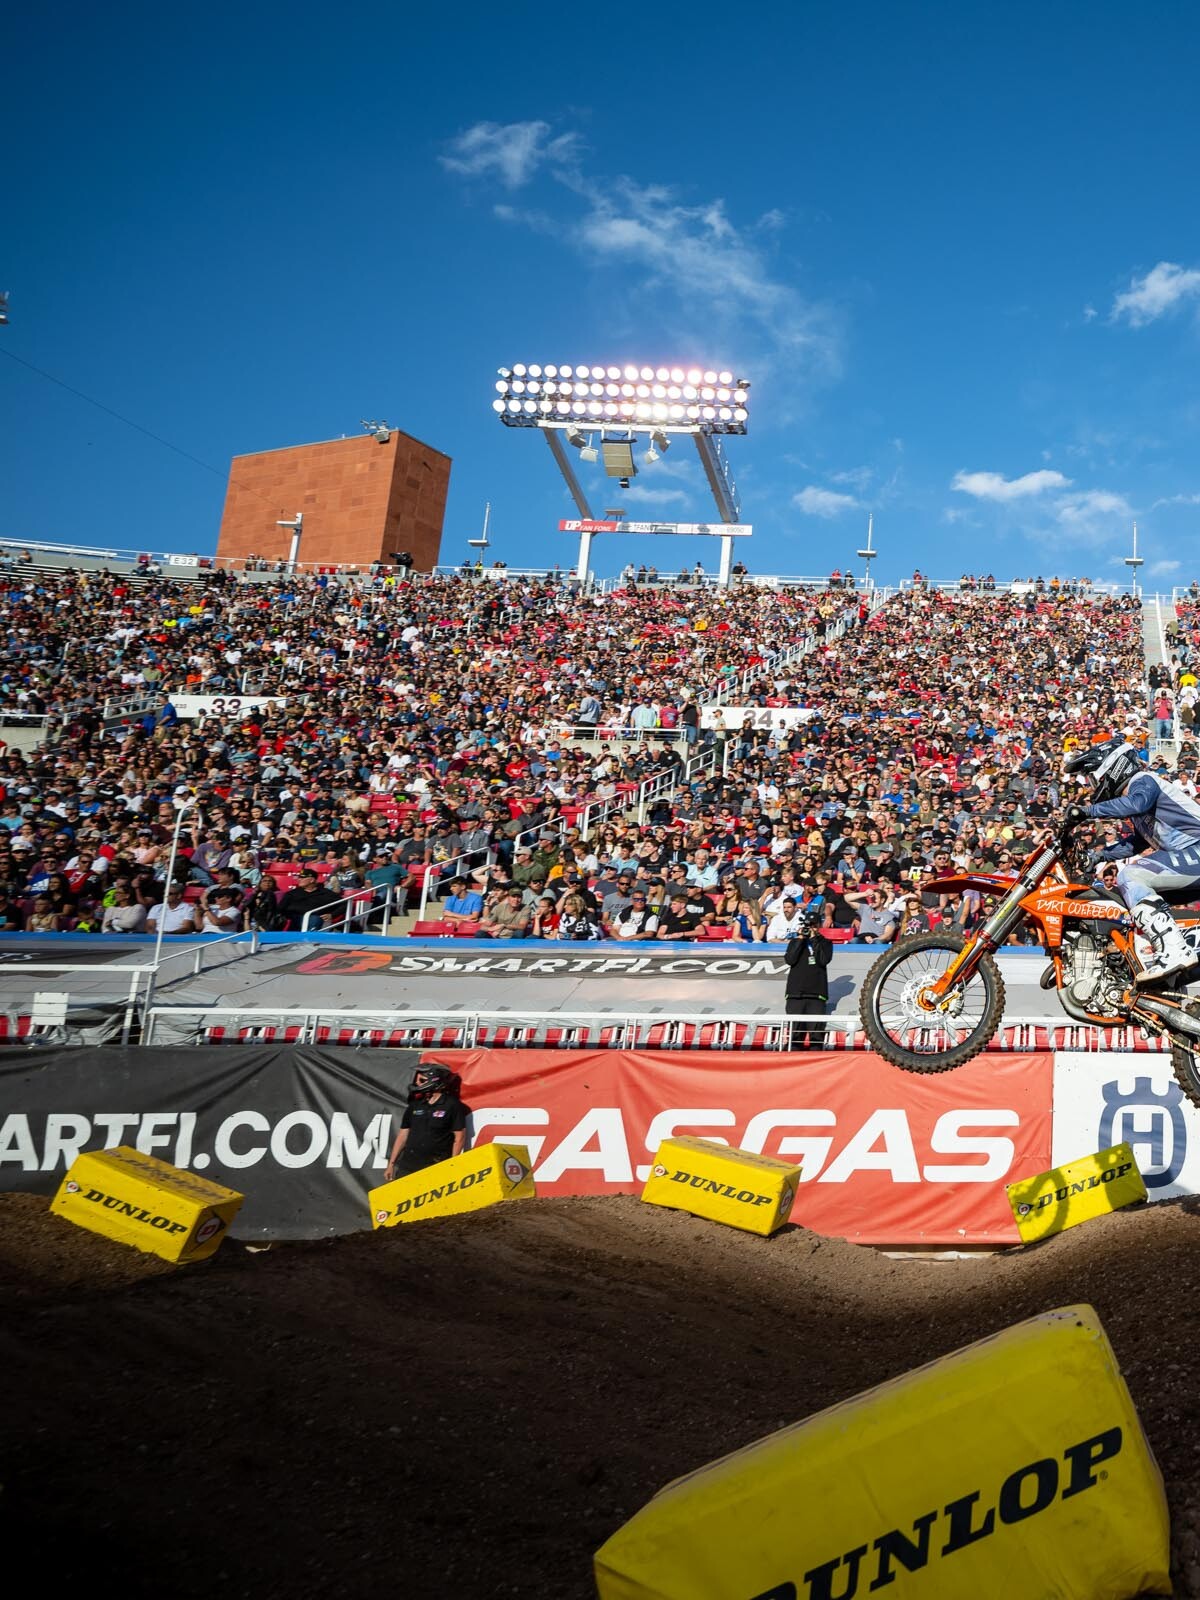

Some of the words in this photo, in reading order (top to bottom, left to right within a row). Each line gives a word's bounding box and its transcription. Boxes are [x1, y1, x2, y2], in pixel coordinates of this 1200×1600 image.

[174, 556, 194, 566] E32
[211, 698, 242, 716] 33
[743, 709, 773, 728] 34
[1068, 902, 1106, 917] COFFEE
[390, 955, 788, 975] SMARTFI.COM
[464, 1107, 1020, 1183] GASGAS
[394, 1166, 493, 1217] DUNLOP
[670, 1170, 774, 1207] DUNLOP
[1036, 1162, 1133, 1210] DUNLOP
[82, 1188, 189, 1235] DUNLOP
